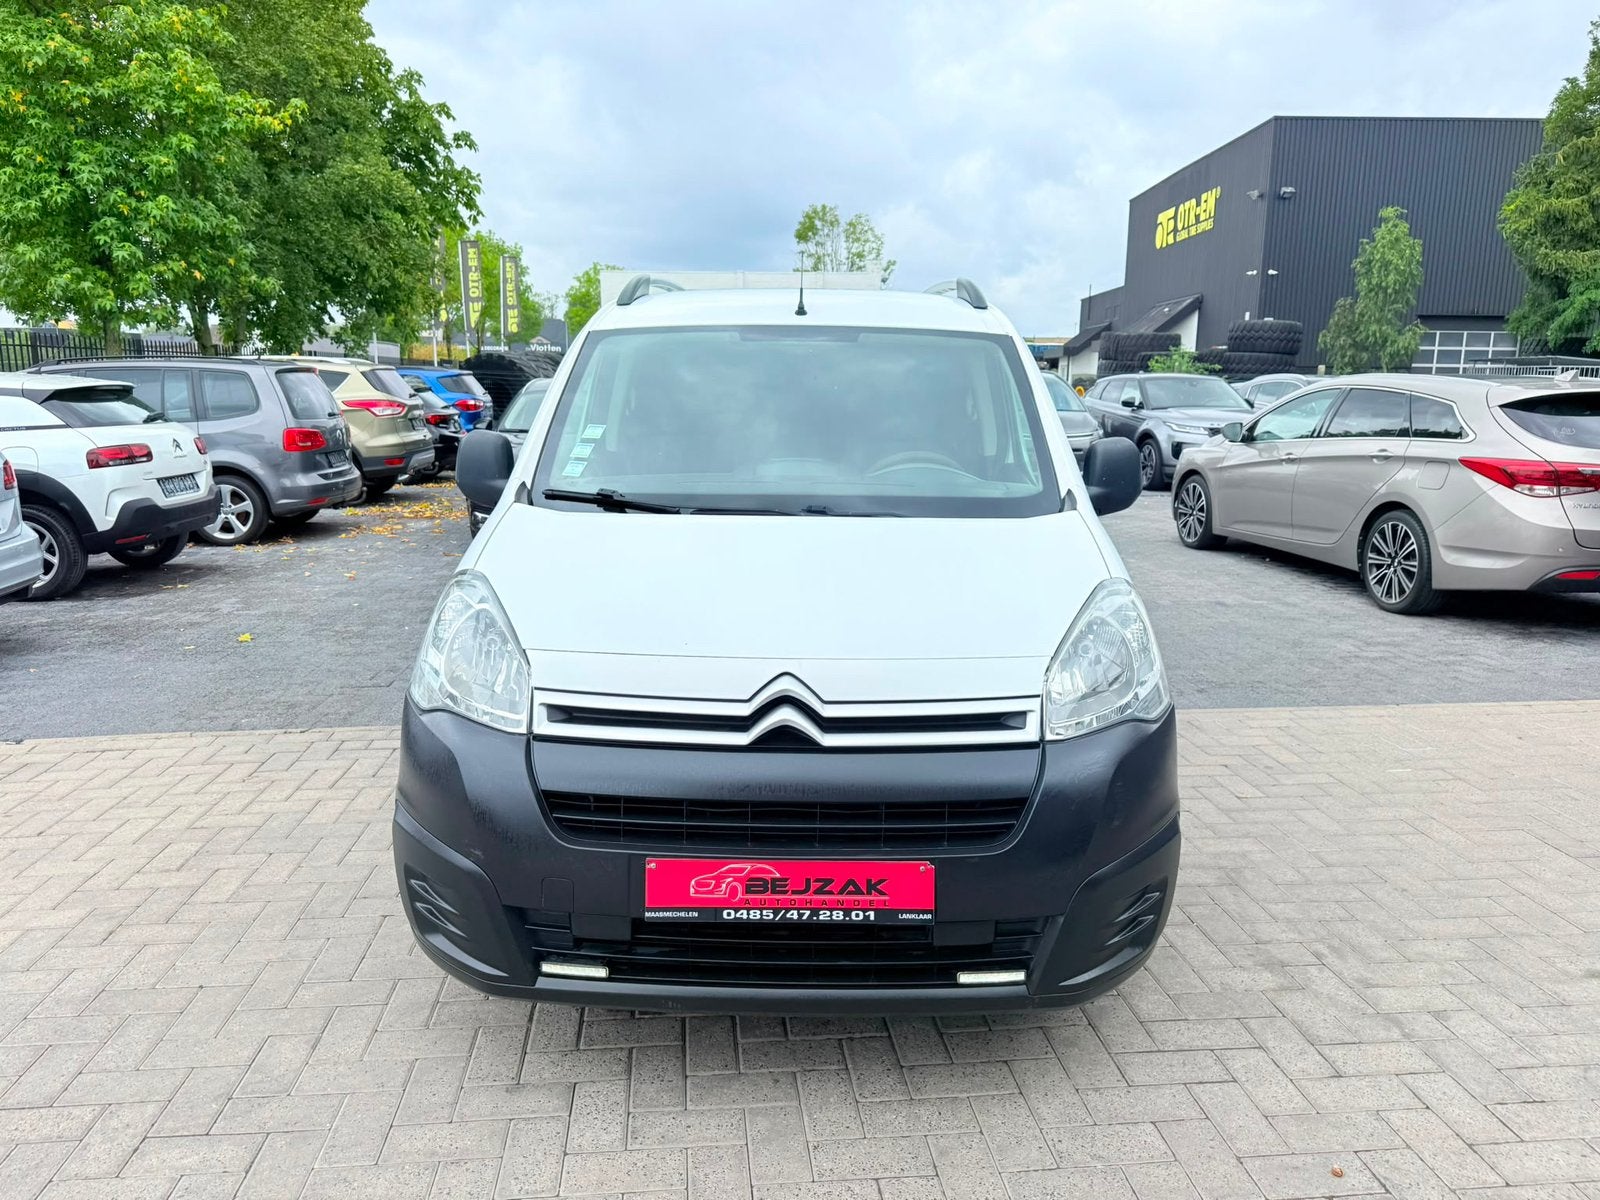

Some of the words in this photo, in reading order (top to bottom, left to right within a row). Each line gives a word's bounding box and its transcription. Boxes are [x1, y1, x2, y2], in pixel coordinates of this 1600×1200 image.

[467, 247, 480, 298] OTR-EM
[506, 262, 515, 306] OTR-EM
[745, 877, 889, 895] BEJZAK
[744, 898, 889, 907] AUTOHANDEL
[722, 909, 875, 921] 0485/47.28.01
